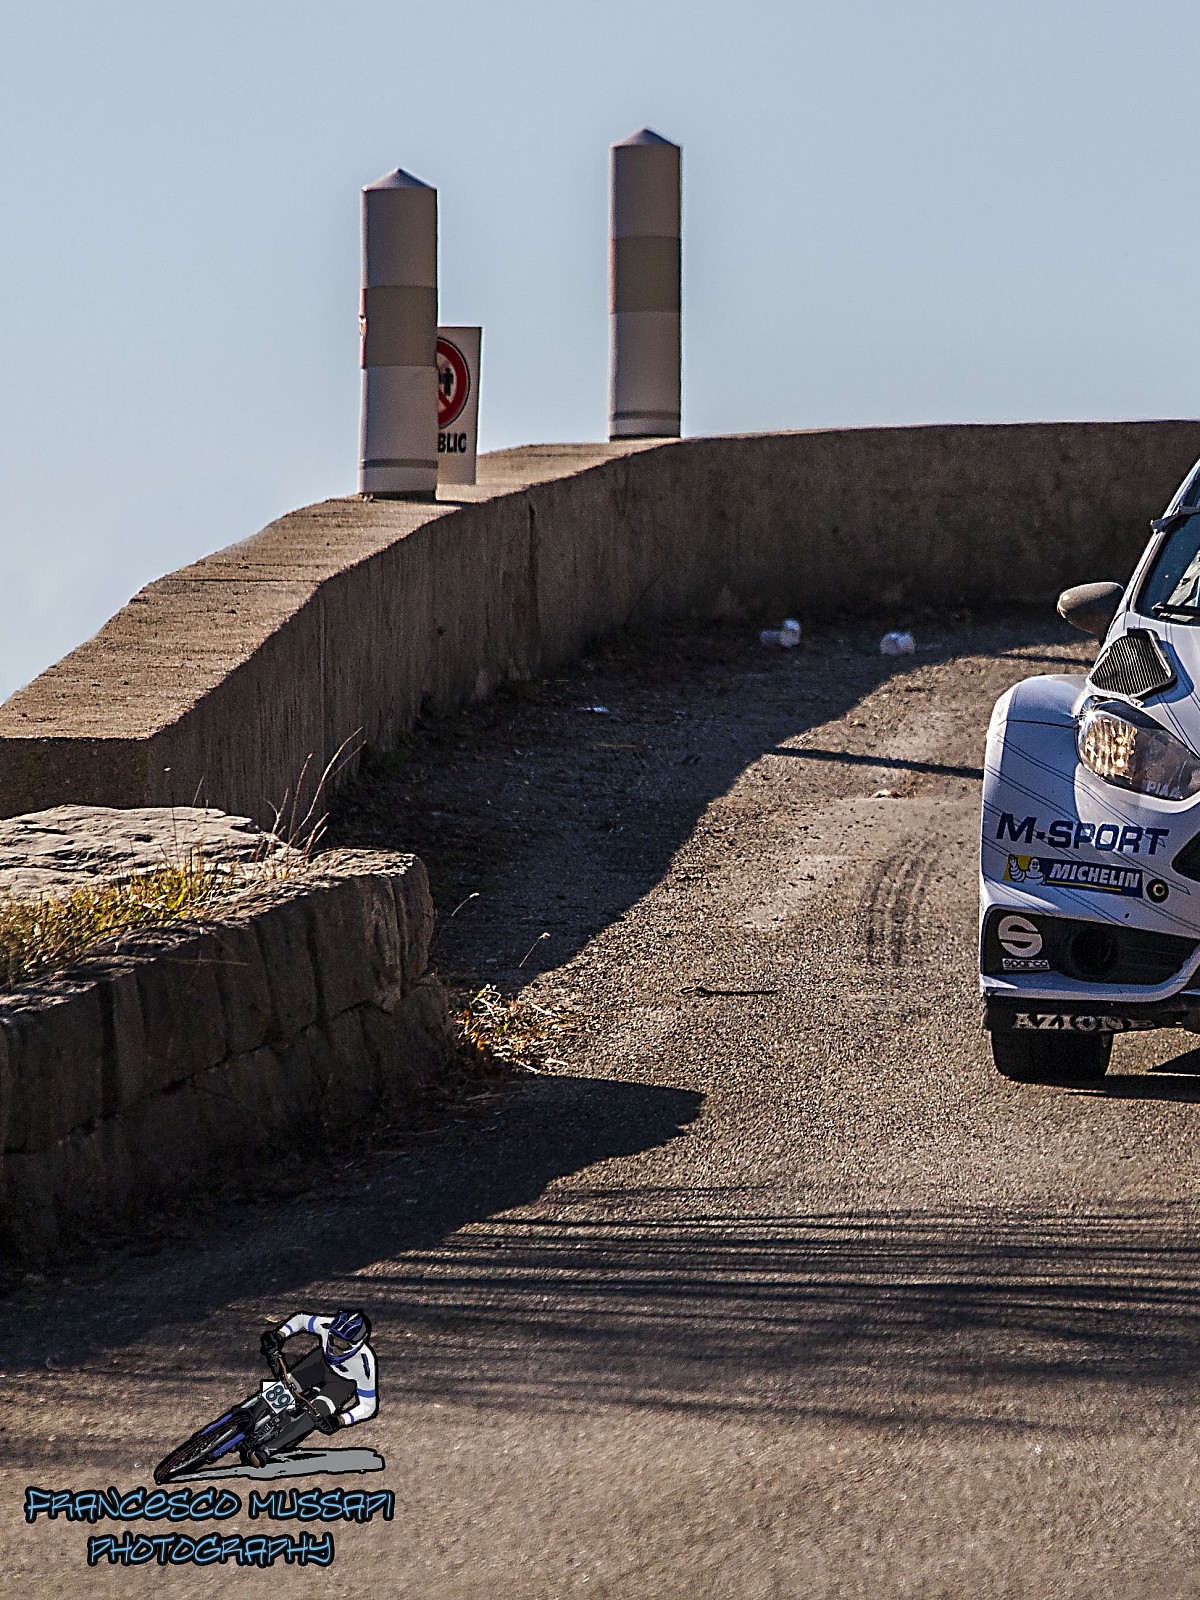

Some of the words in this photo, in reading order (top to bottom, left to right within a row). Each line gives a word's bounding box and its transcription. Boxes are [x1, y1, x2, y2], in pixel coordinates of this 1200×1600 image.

[438, 433, 467, 453] BLIC
[1145, 780, 1181, 800] PIAA
[995, 813, 1170, 855] M-SPORT
[1050, 863, 1141, 889] MICHELIN
[1011, 1012, 1156, 1032] AZIONE
